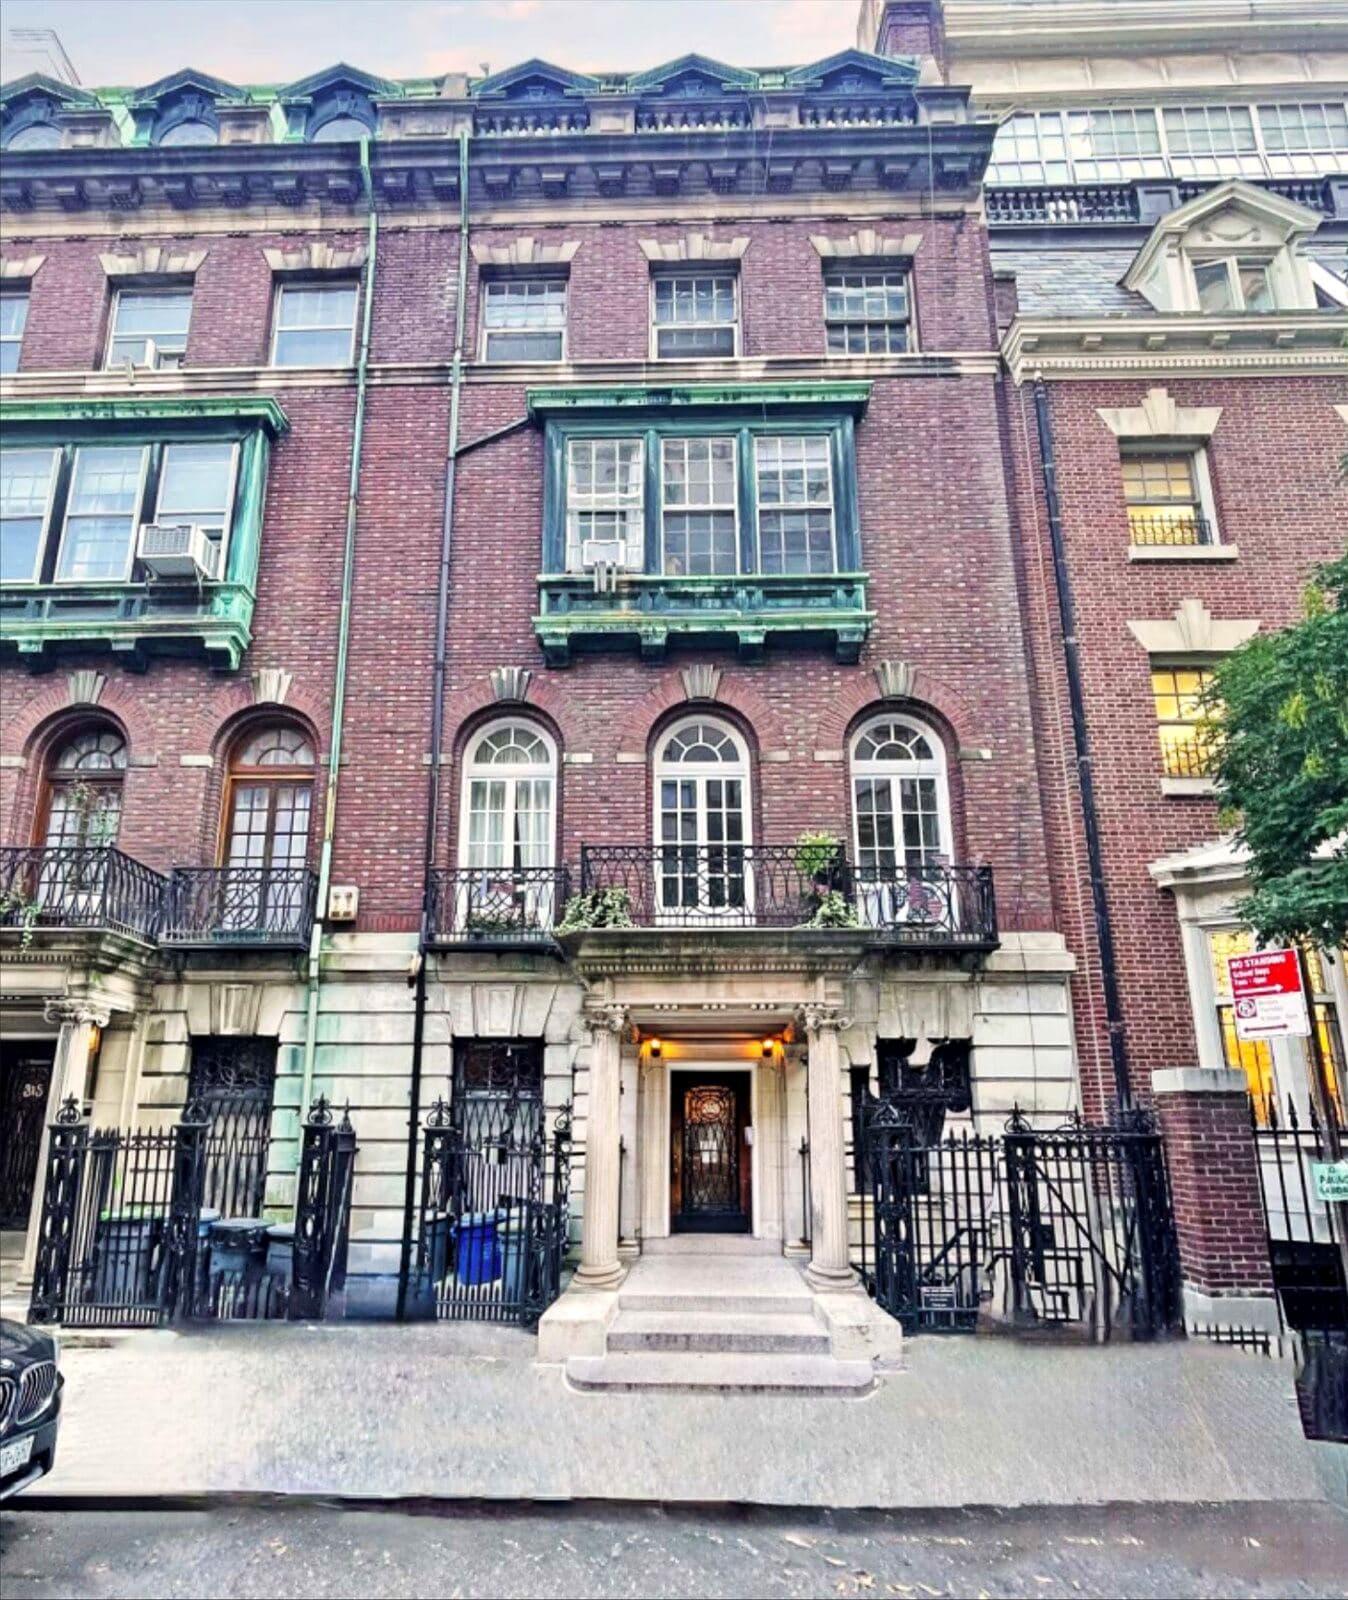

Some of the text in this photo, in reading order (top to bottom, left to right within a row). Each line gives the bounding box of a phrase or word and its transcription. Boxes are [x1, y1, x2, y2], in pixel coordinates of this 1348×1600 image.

[1231, 954, 1286, 969] NO STANDING
[22, 1083, 44, 1098] 315
